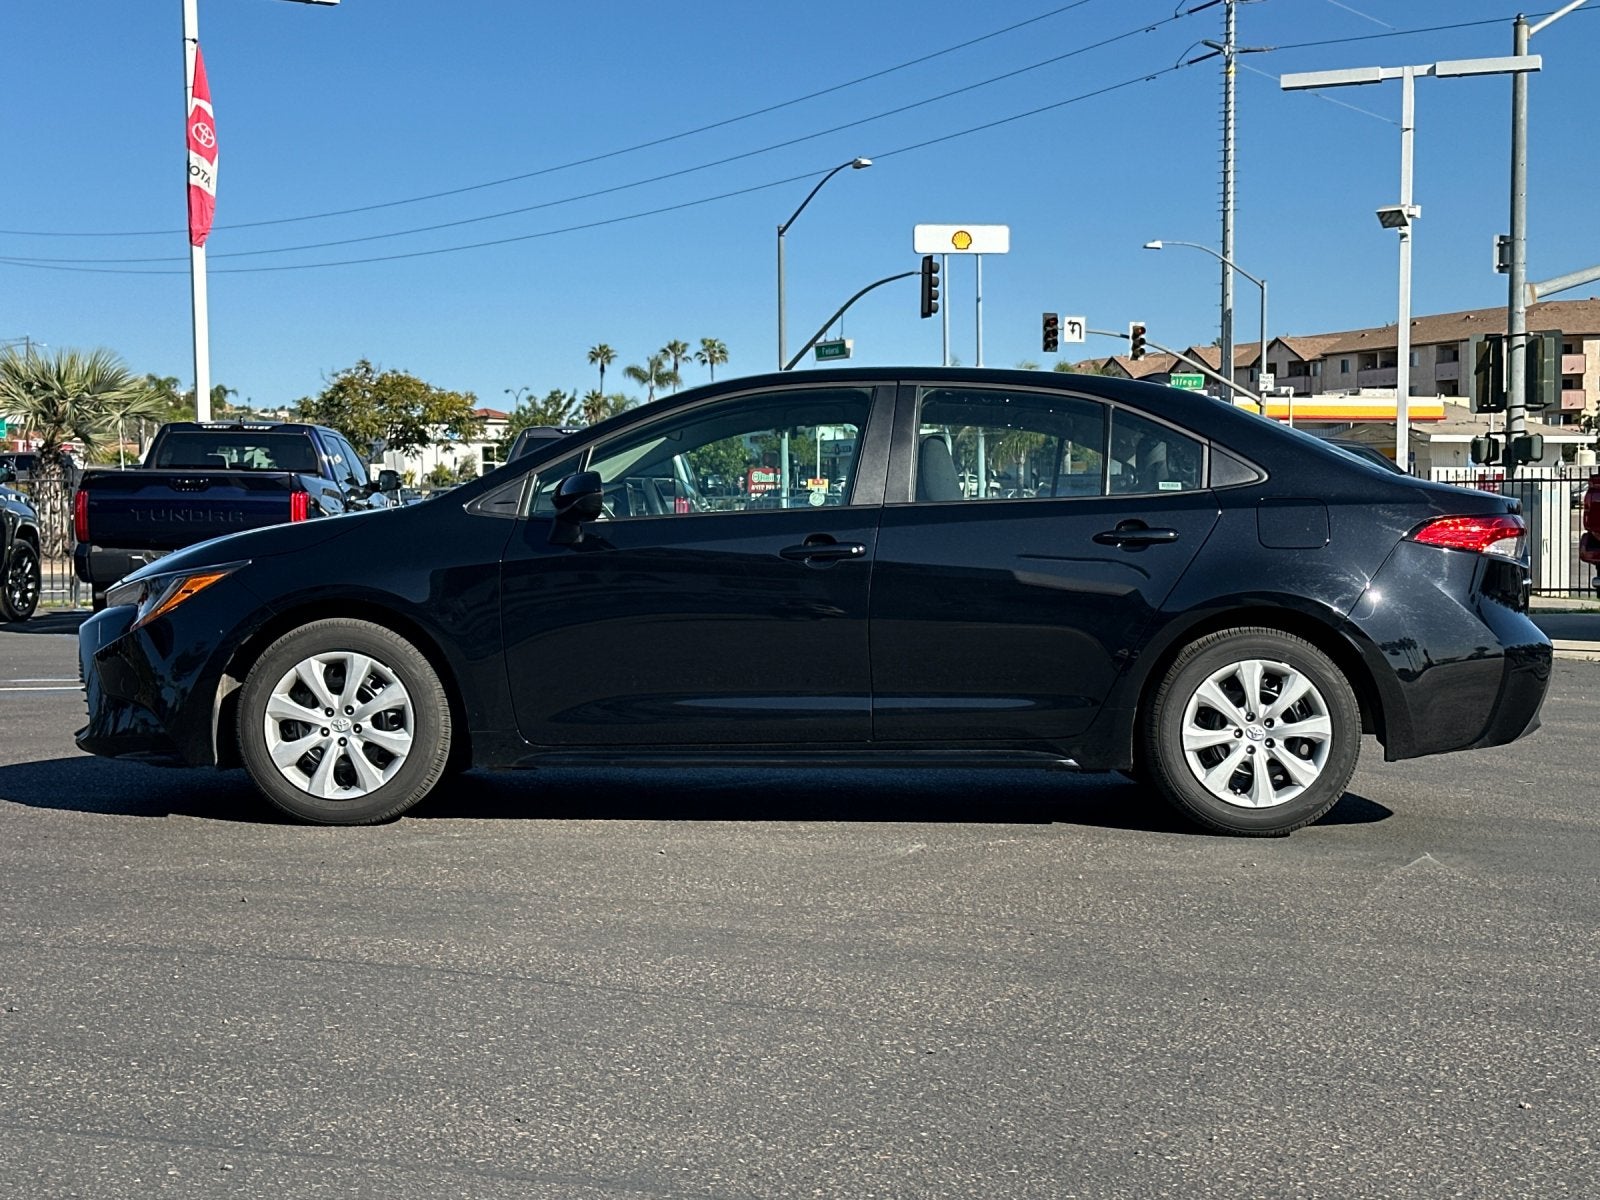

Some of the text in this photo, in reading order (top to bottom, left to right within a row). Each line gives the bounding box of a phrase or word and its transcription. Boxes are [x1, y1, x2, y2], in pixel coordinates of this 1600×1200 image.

[189, 165, 211, 188] OTA
[1170, 378, 1198, 387] ollege
[130, 509, 245, 522] TUNDRA
